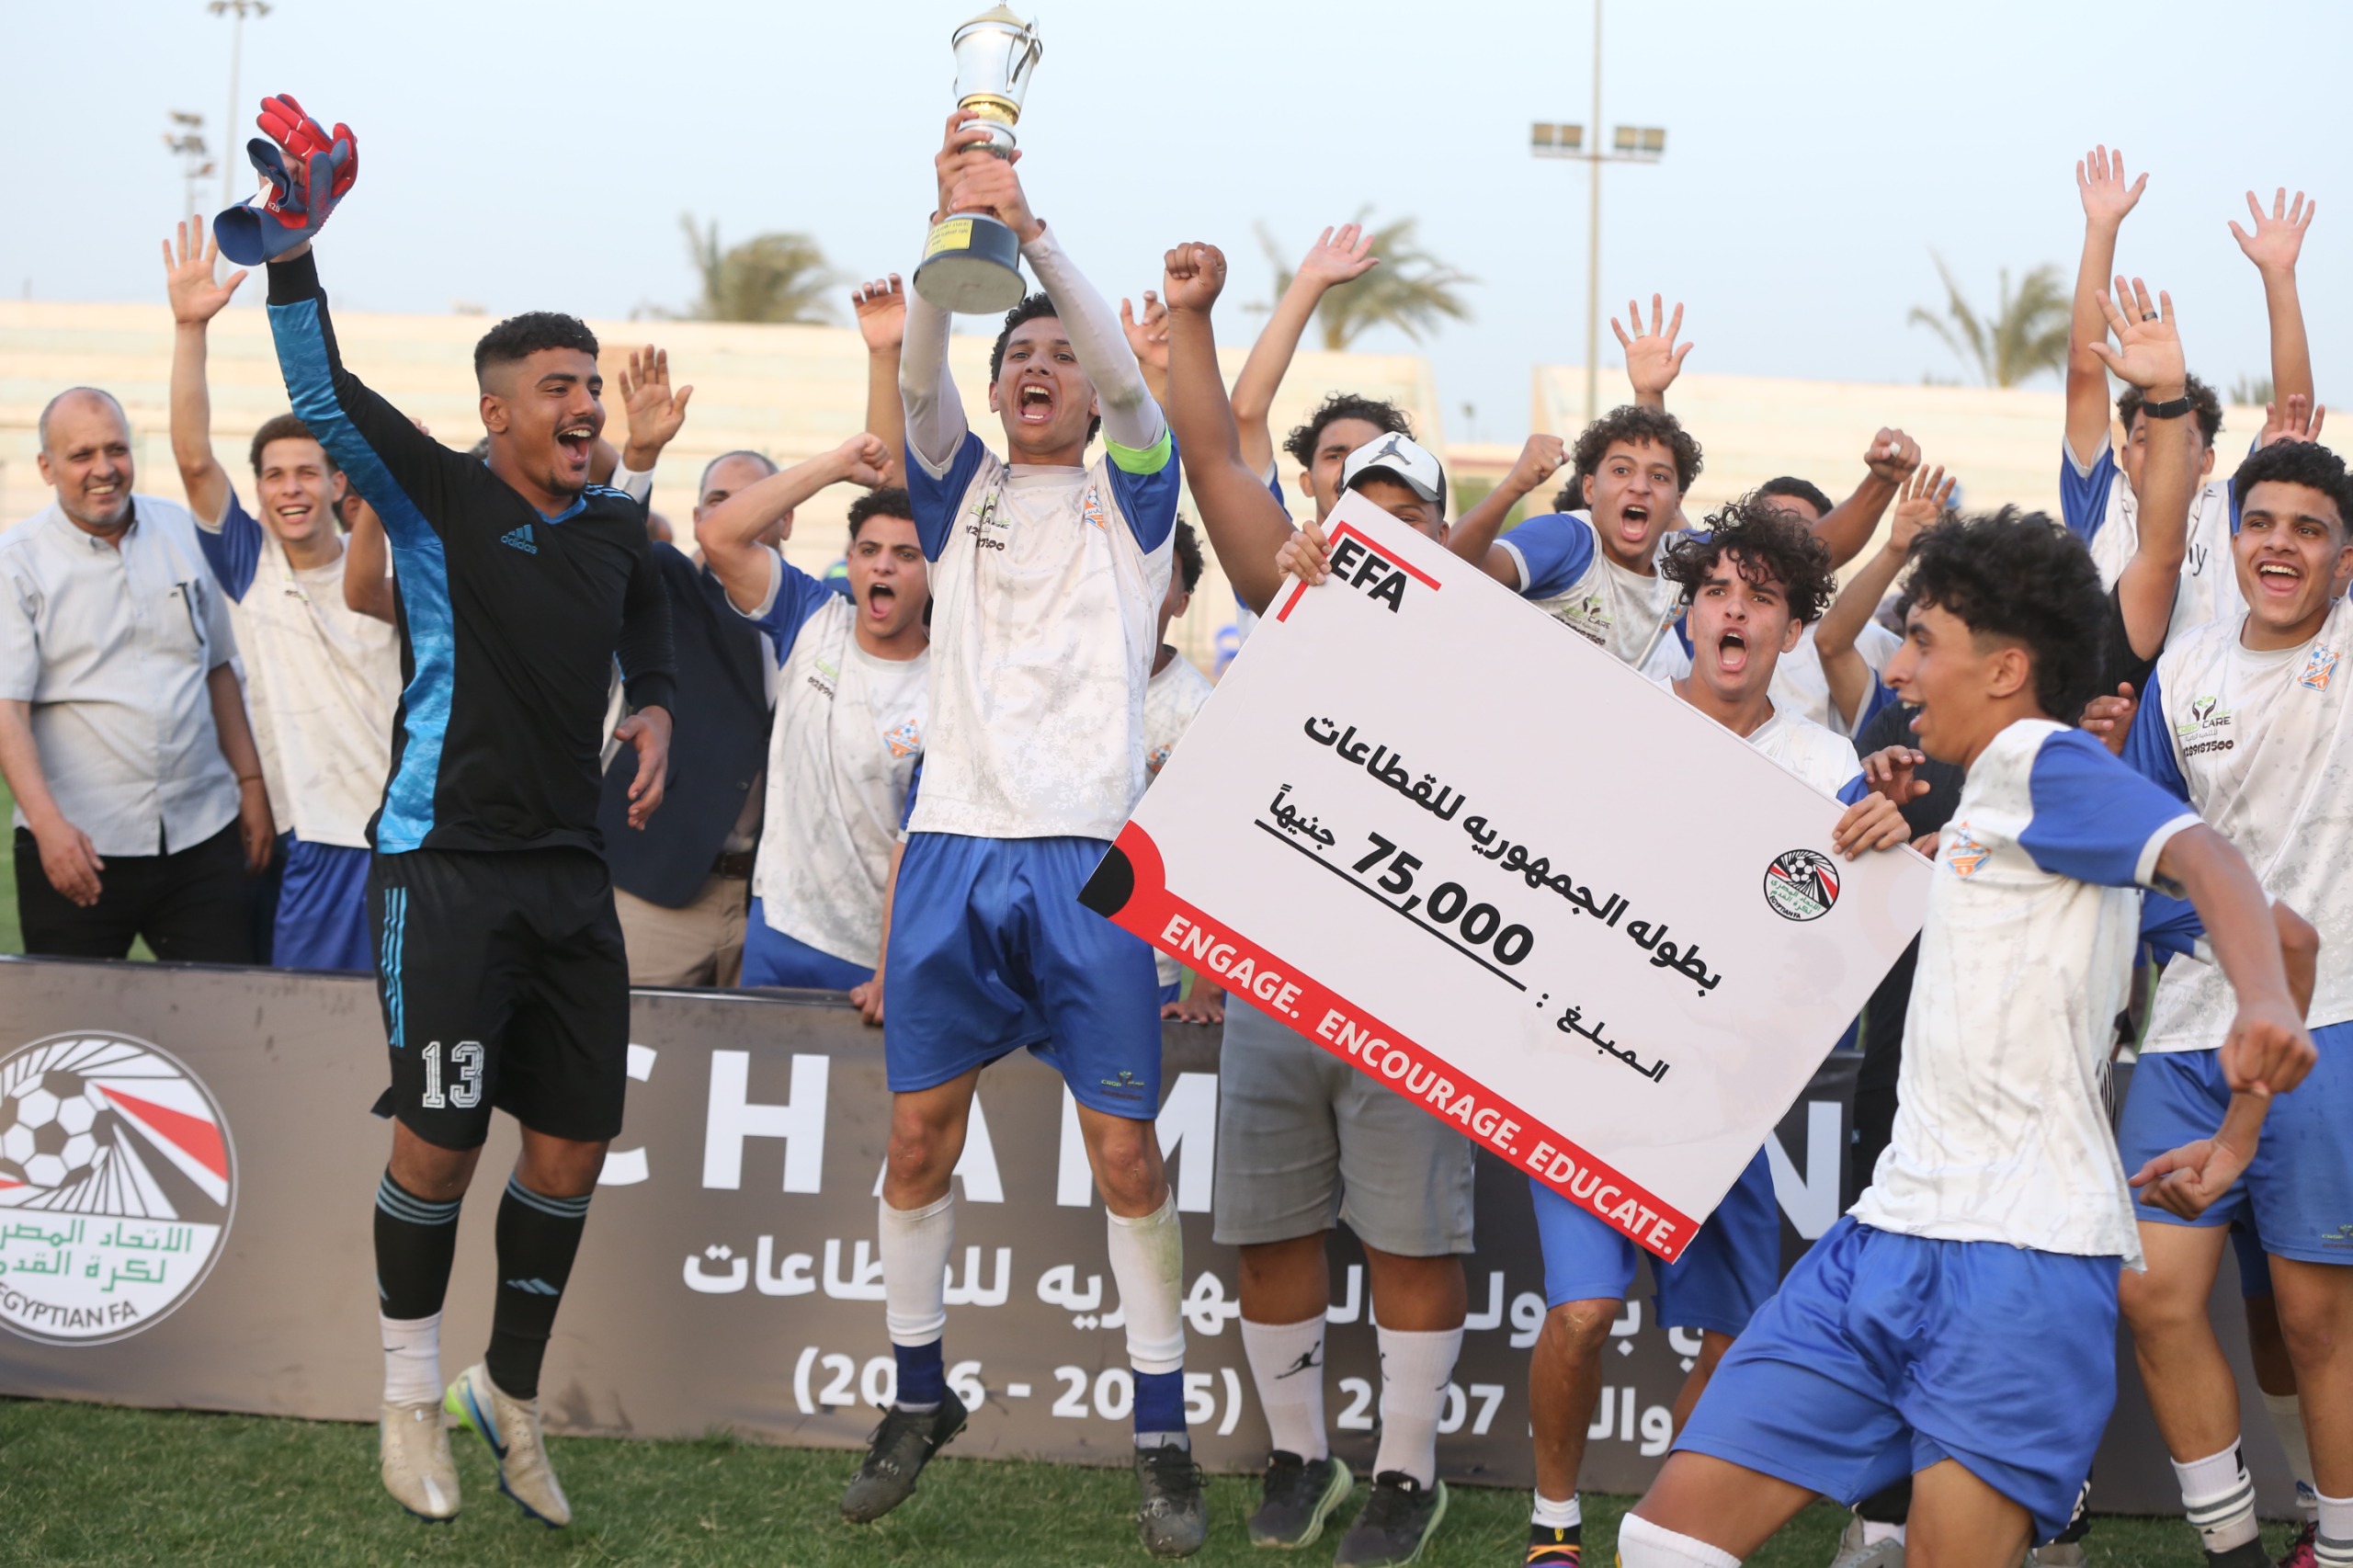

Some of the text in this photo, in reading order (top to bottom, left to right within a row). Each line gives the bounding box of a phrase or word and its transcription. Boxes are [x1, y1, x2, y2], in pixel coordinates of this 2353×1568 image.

[500, 535, 538, 554] adidas
[1329, 537, 1407, 614] EFA
[2202, 716, 2232, 729] CARE
[1303, 715, 1722, 997] بطوله الجمهوريه للقطاعات
[1352, 831, 1534, 966] 75,000
[1769, 894, 1793, 917] EGYPTIAN
[422, 1040, 484, 1108] 13
[1556, 1005, 1670, 1084] المبلغ
[1160, 913, 1677, 1256] ENGAGE. ENCOURAGE. EDUCATE.
[0, 1218, 193, 1254] الاتحاد المصر
[85, 1255, 165, 1293] لكرة
[108, 1300, 139, 1324] FA
[793, 1346, 987, 1415] (206
[1051, 1365, 1243, 1436] 205)
[1336, 1377, 1505, 1436] 207
